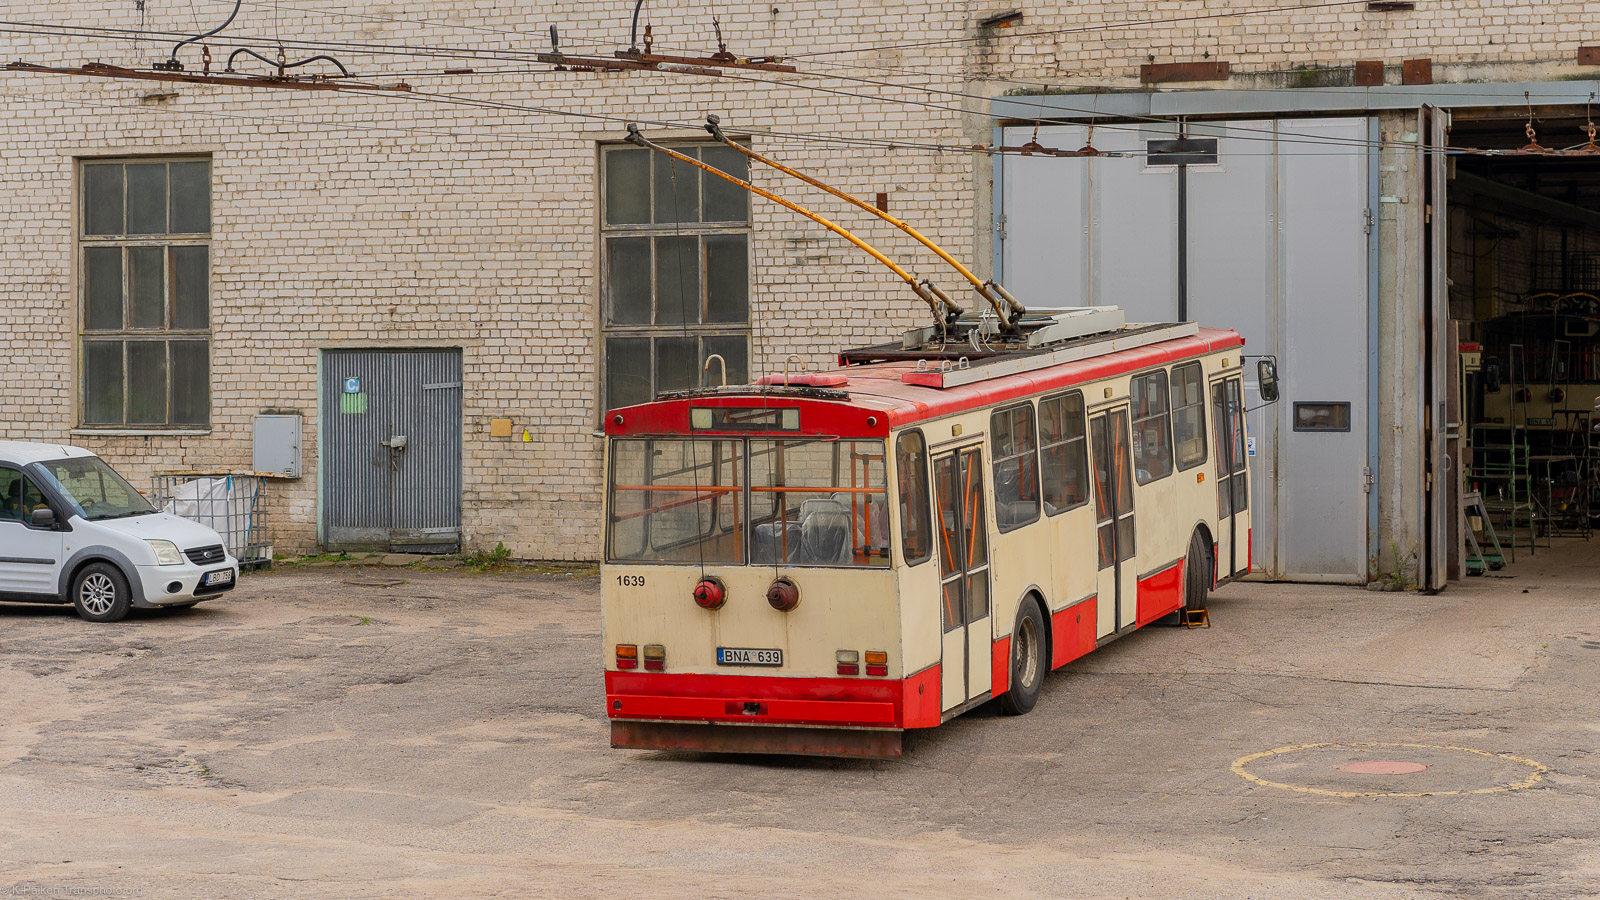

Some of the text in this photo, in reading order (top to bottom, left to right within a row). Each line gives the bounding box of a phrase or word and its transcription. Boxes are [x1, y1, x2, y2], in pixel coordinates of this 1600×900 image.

[616, 575, 646, 587] 1639
[725, 650, 780, 663] BNA 639
